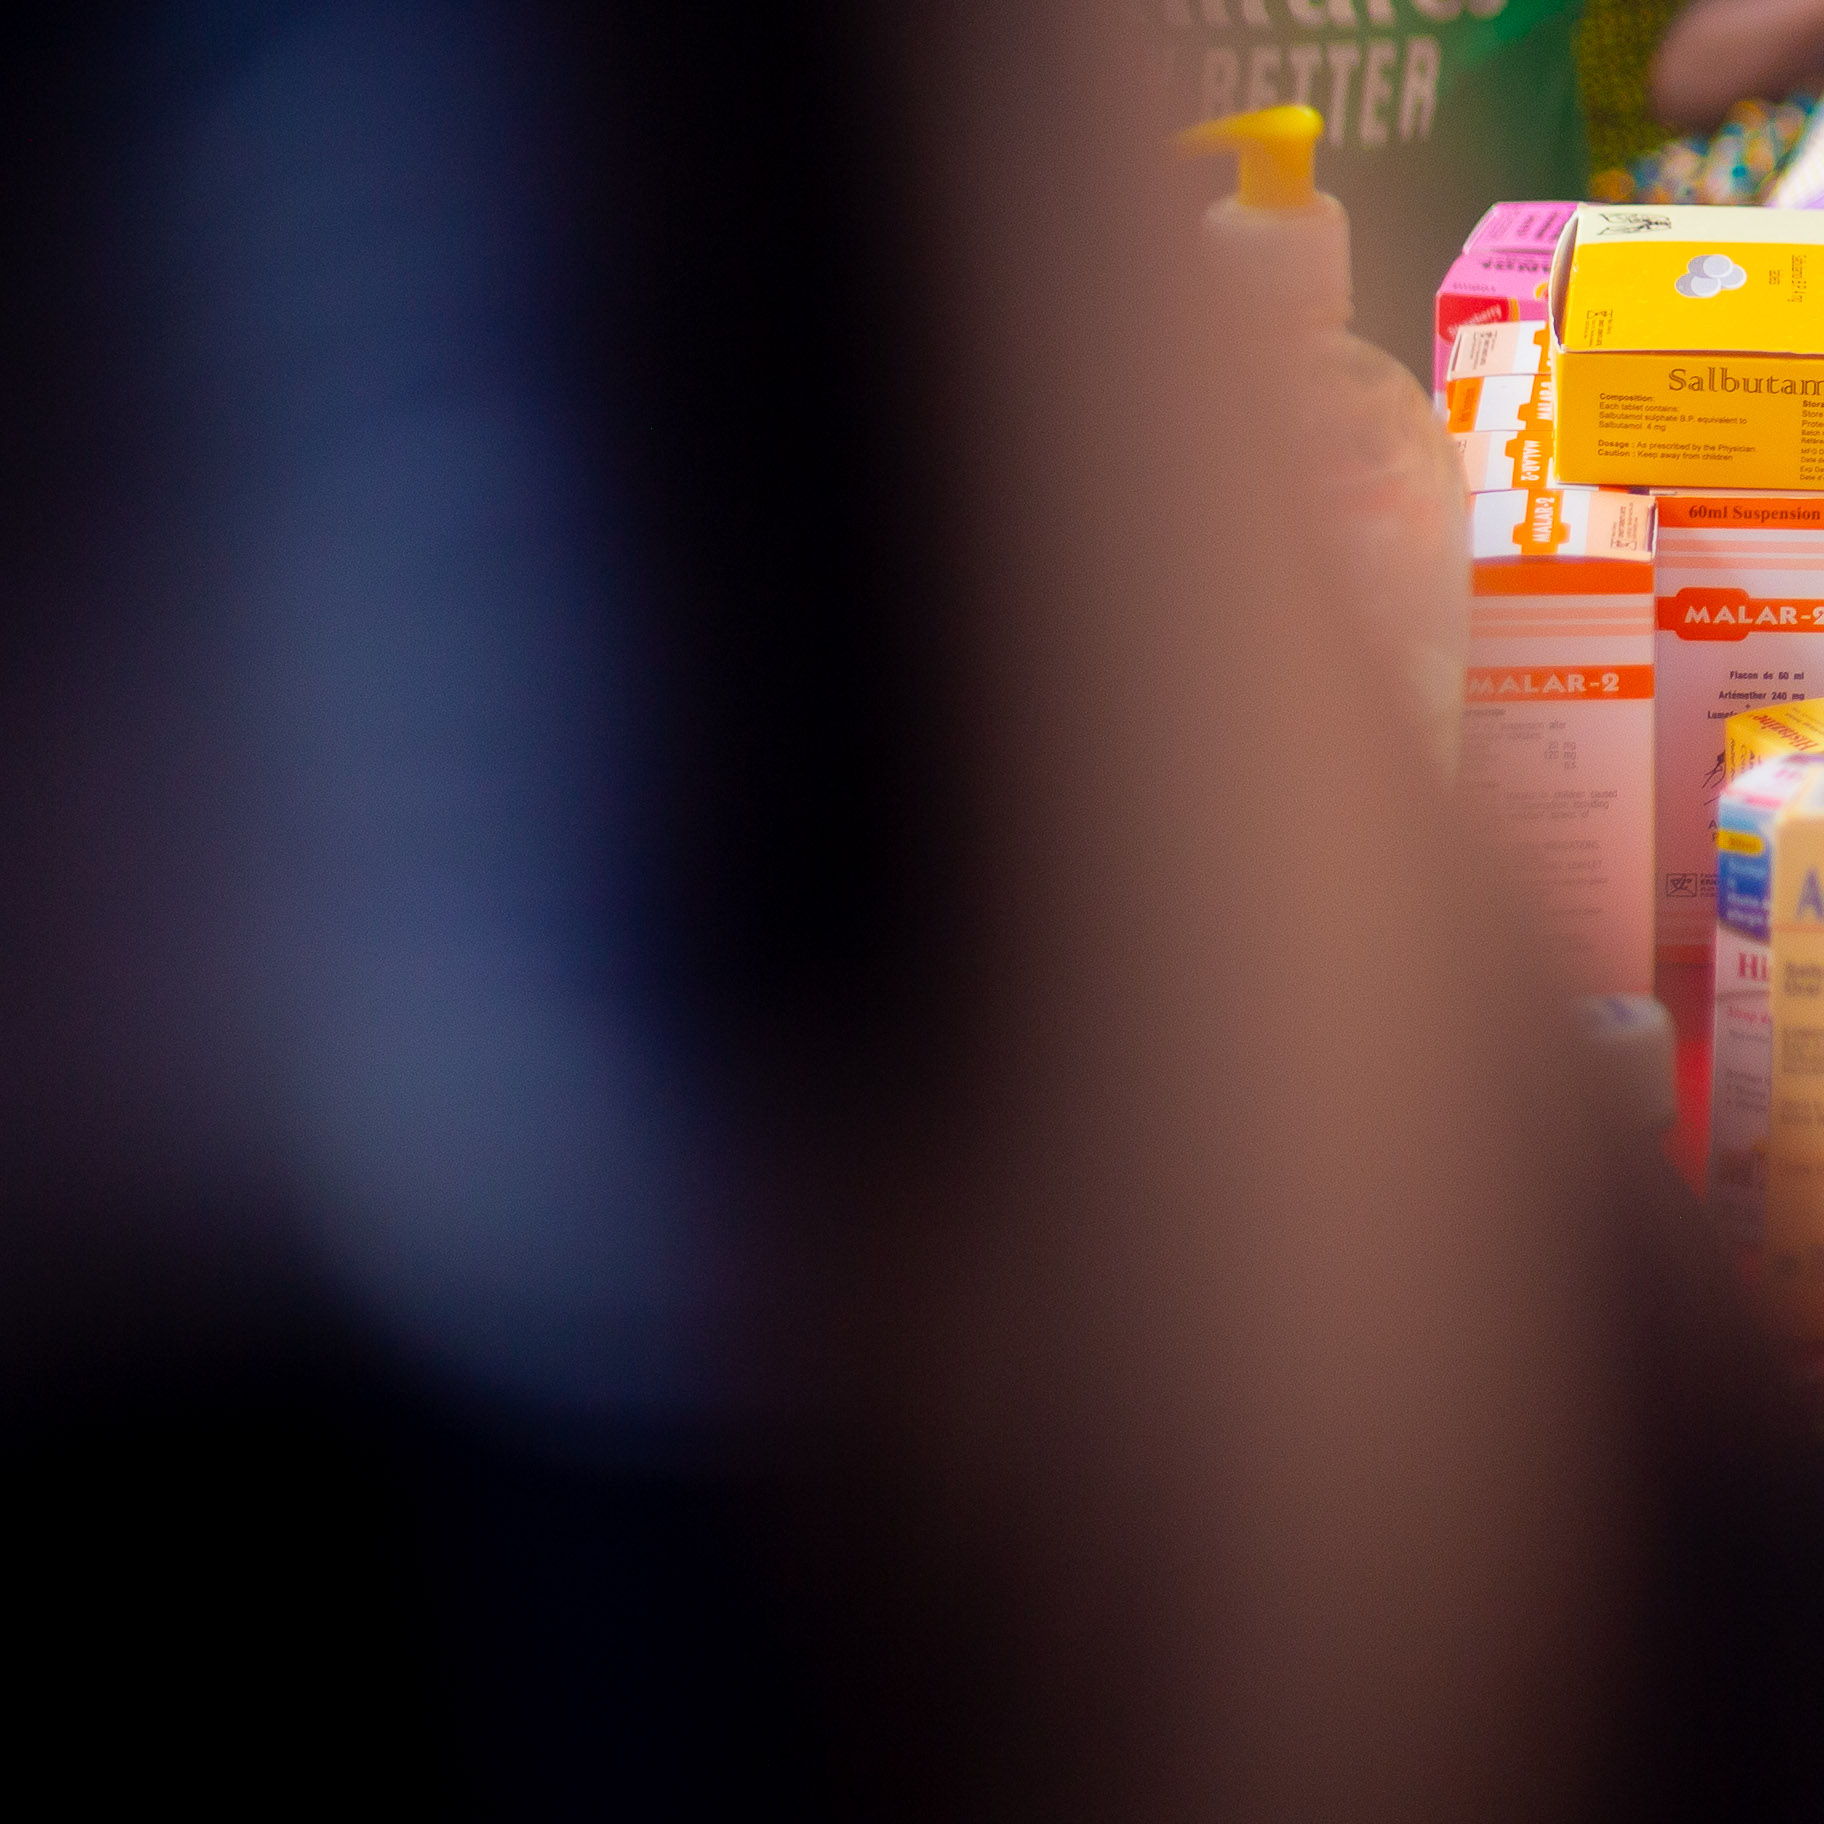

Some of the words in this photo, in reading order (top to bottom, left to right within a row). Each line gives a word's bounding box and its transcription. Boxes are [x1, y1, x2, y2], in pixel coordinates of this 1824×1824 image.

[1599, 402, 1619, 410] Each
[1620, 403, 1644, 411] tablet
[1598, 411, 1643, 421] Salbutamol
[1644, 414, 1678, 423] sulphate
[1697, 416, 1738, 426] equivalent
[1739, 417, 1748, 425] to
[1801, 410, 1824, 419] Store
[1598, 420, 1642, 430] Salbutamol
[1653, 424, 1667, 432] mg
[1597, 439, 1630, 449] Dosage
[1636, 441, 1647, 449] As
[1649, 442, 1691, 452] prescribed
[1692, 444, 1702, 453] by
[1702, 444, 1716, 452] the
[1520, 439, 1544, 482] MALAR-2
[1597, 449, 1630, 457] Caution
[1637, 451, 1658, 460] Keep
[1660, 452, 1681, 461] away
[1682, 453, 1700, 461] from
[1702, 453, 1733, 462] children
[1531, 496, 1556, 544] MALAR-2
[1688, 504, 1728, 520] 60ml
[1731, 505, 1821, 523] Suspension
[1729, 670, 1758, 680] Flacon
[1763, 671, 1774, 680] de
[1793, 672, 1805, 680] ml
[1467, 673, 1620, 695] MALAR-2
[1771, 691, 1787, 701] 240
